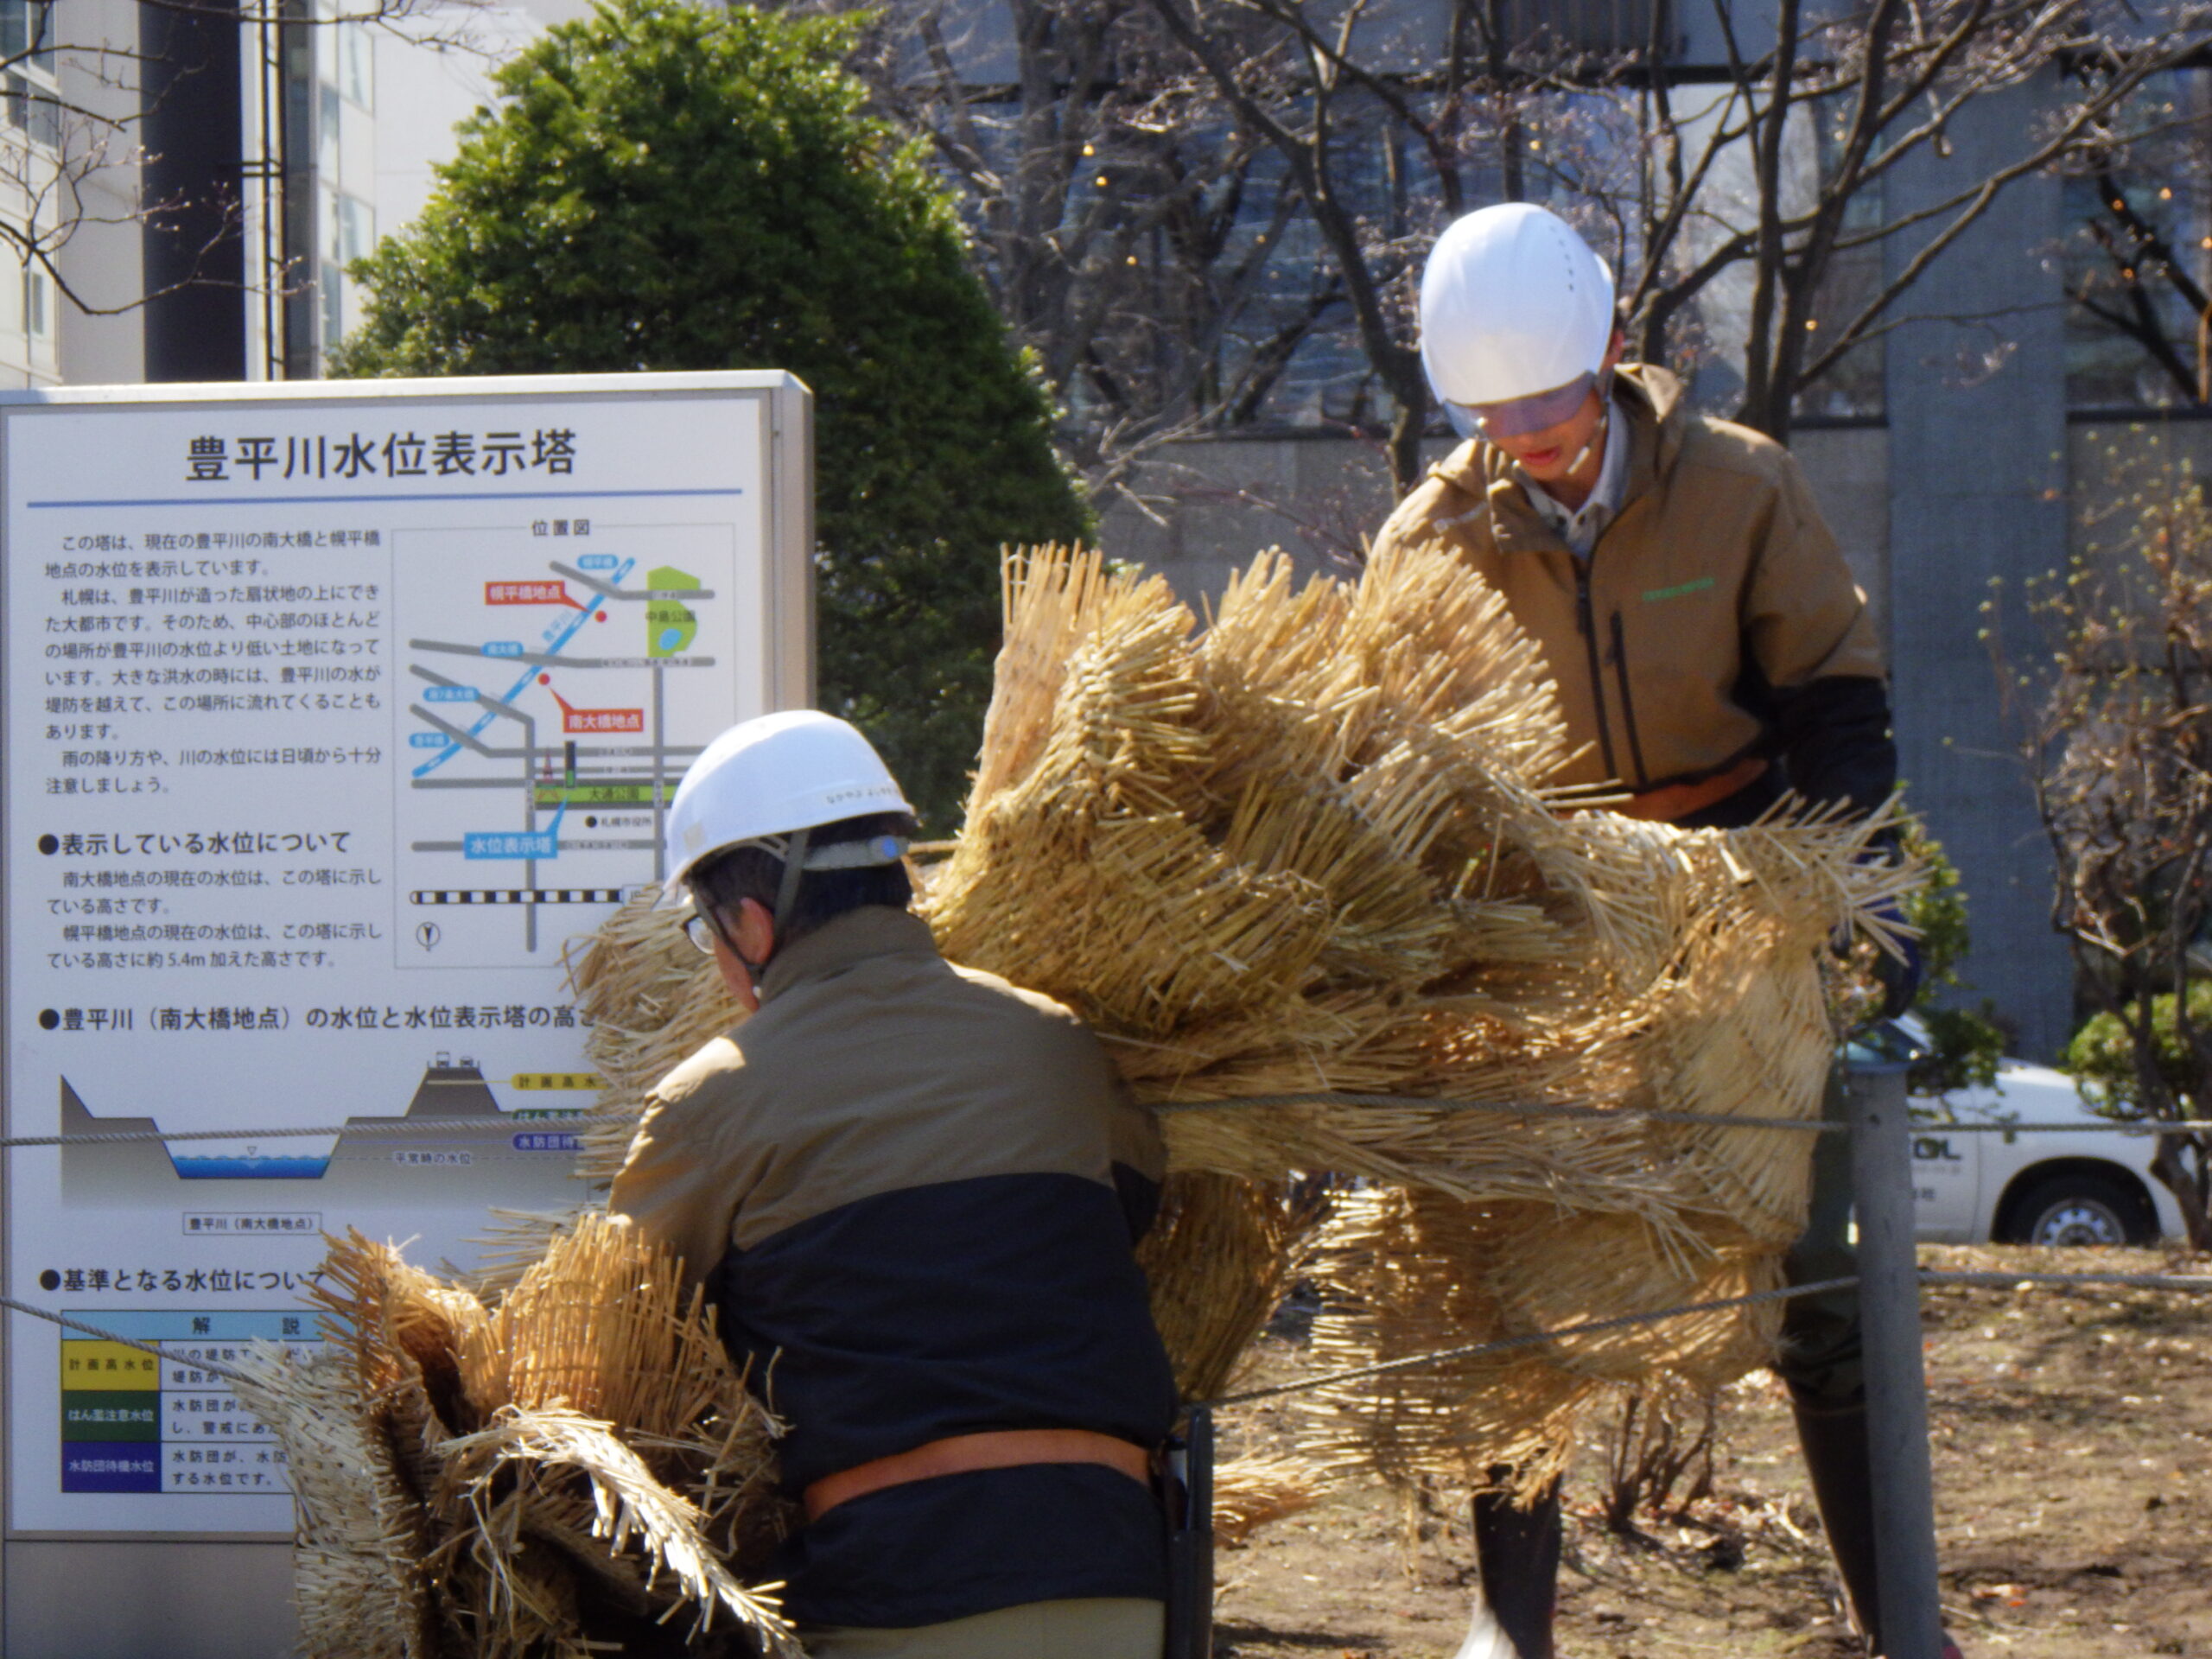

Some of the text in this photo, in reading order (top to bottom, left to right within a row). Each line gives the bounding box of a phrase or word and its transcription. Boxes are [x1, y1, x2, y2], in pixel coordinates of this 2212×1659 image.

[185, 428, 577, 482] 豊平川水位表示塔
[62, 529, 381, 552] この塔は、現在の豊平川の南大橋と幌平橋
[45, 558, 270, 580] 地点の水位を表示しています。
[61, 584, 379, 607] 札幌は、豊平川が造った扇状地の上にでき
[45, 611, 380, 633] た大都市です。そのため、中心部のほとんど
[45, 638, 380, 660] の場所が豊平川の水位より低い土地になって
[45, 664, 381, 687] います。大きな洪水の時には、豊平川の水が
[45, 692, 381, 715] 堤防を越えて、この場所に流れてくることも
[45, 722, 120, 741] あります。
[569, 714, 640, 729] 南大橋地点
[62, 747, 381, 768] 雨の降り方や、川の水位には日頃から十分
[46, 776, 170, 795] 注意しましょう。
[62, 831, 352, 856] 表示している水位について
[471, 836, 552, 855] 水位表示塔
[62, 868, 382, 888] 南大橋地点の現在の水位は、この塔に示し
[47, 897, 170, 916] ている高さです。
[62, 923, 383, 942] 幌平橋地点の現在の水位は、この塔に示し
[189, 1217, 314, 1231] 豊平川（南大橋地点）
[69, 1358, 154, 1371] 計画高水位
[172, 1471, 272, 1486] する水位です。
